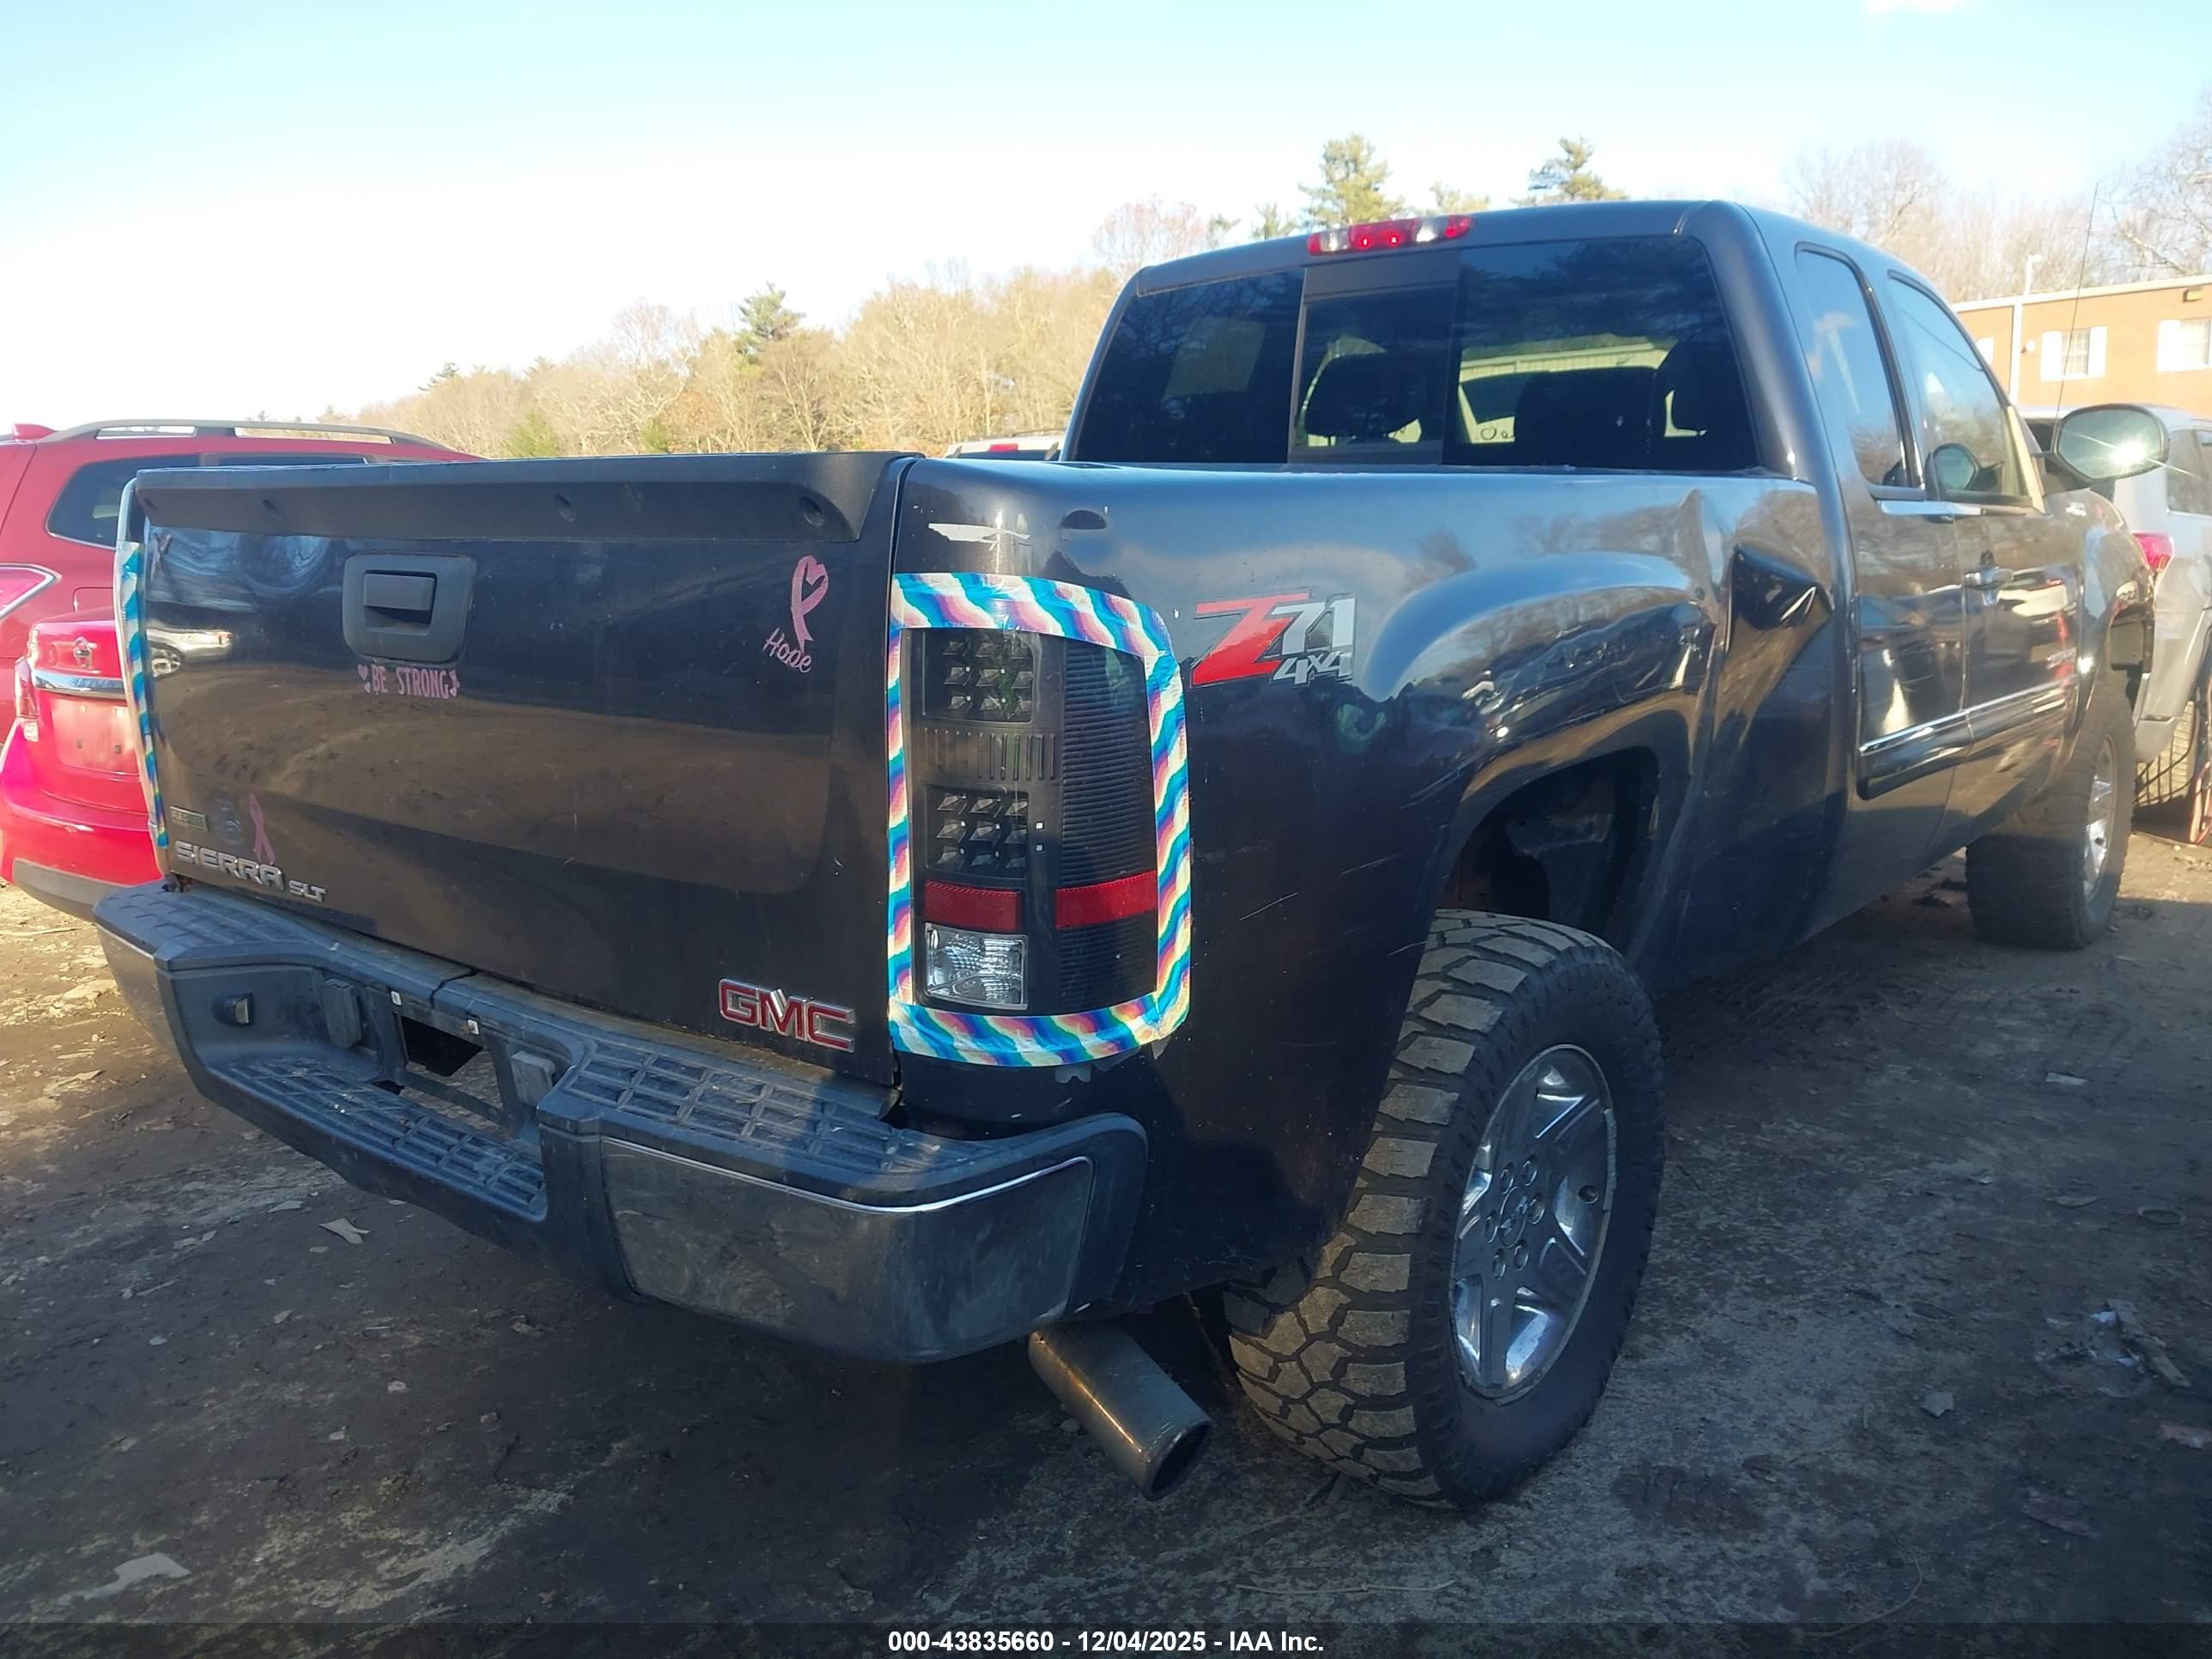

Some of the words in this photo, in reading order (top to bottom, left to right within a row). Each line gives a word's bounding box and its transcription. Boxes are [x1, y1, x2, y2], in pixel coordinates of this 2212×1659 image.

[763, 627, 812, 673] Hope
[1192, 592, 1356, 685] Z71
[371, 664, 388, 694] BE
[396, 666, 449, 699] STRONG
[175, 841, 285, 890] SIERRA
[288, 880, 326, 902] SLT
[718, 978, 855, 1053] GMC
